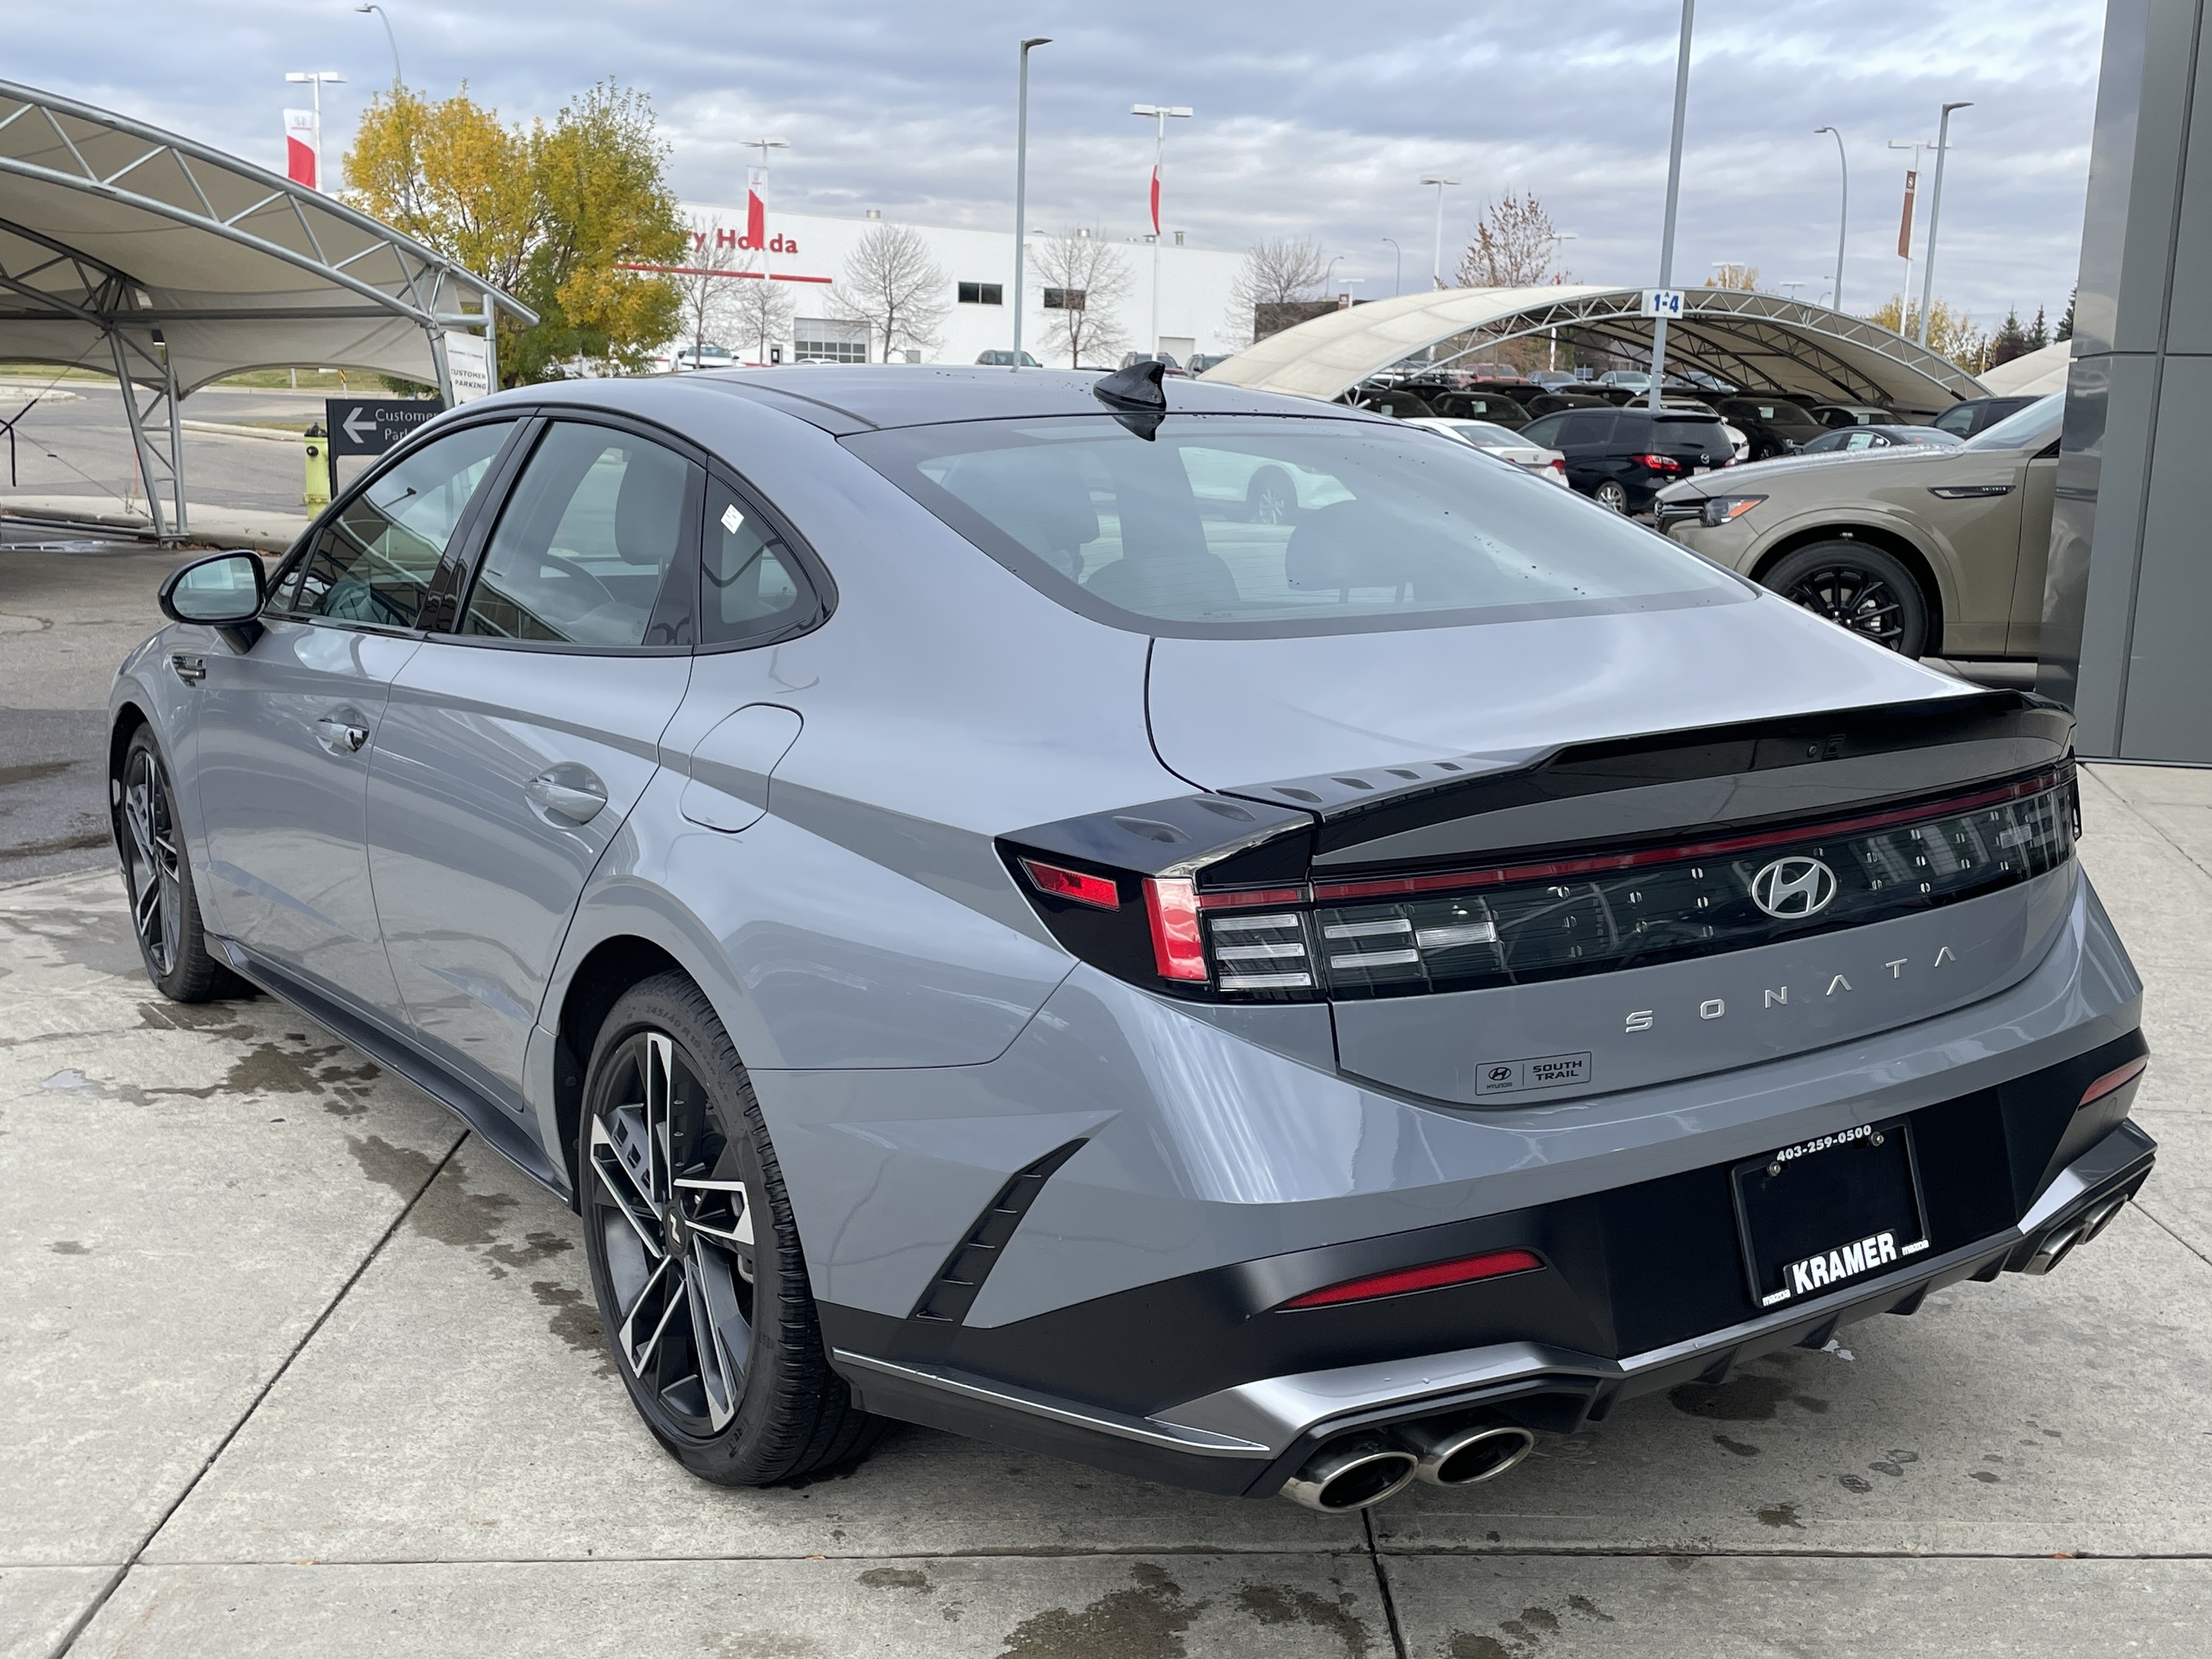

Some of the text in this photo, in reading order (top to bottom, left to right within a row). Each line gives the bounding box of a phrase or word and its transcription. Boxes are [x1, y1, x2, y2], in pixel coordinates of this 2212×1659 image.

[717, 228, 798, 254] Hoda
[1654, 294, 1679, 313] 1-4
[451, 369, 486, 379] CUSTOMER
[455, 379, 486, 389] PARKING
[1624, 946, 1956, 1033] SONATA
[1532, 1060, 1582, 1073] SOUTH
[1535, 1070, 1579, 1081] TRAIL
[1777, 1124, 1872, 1161] 403-259-0500
[1792, 1232, 1897, 1294] KRAMER
